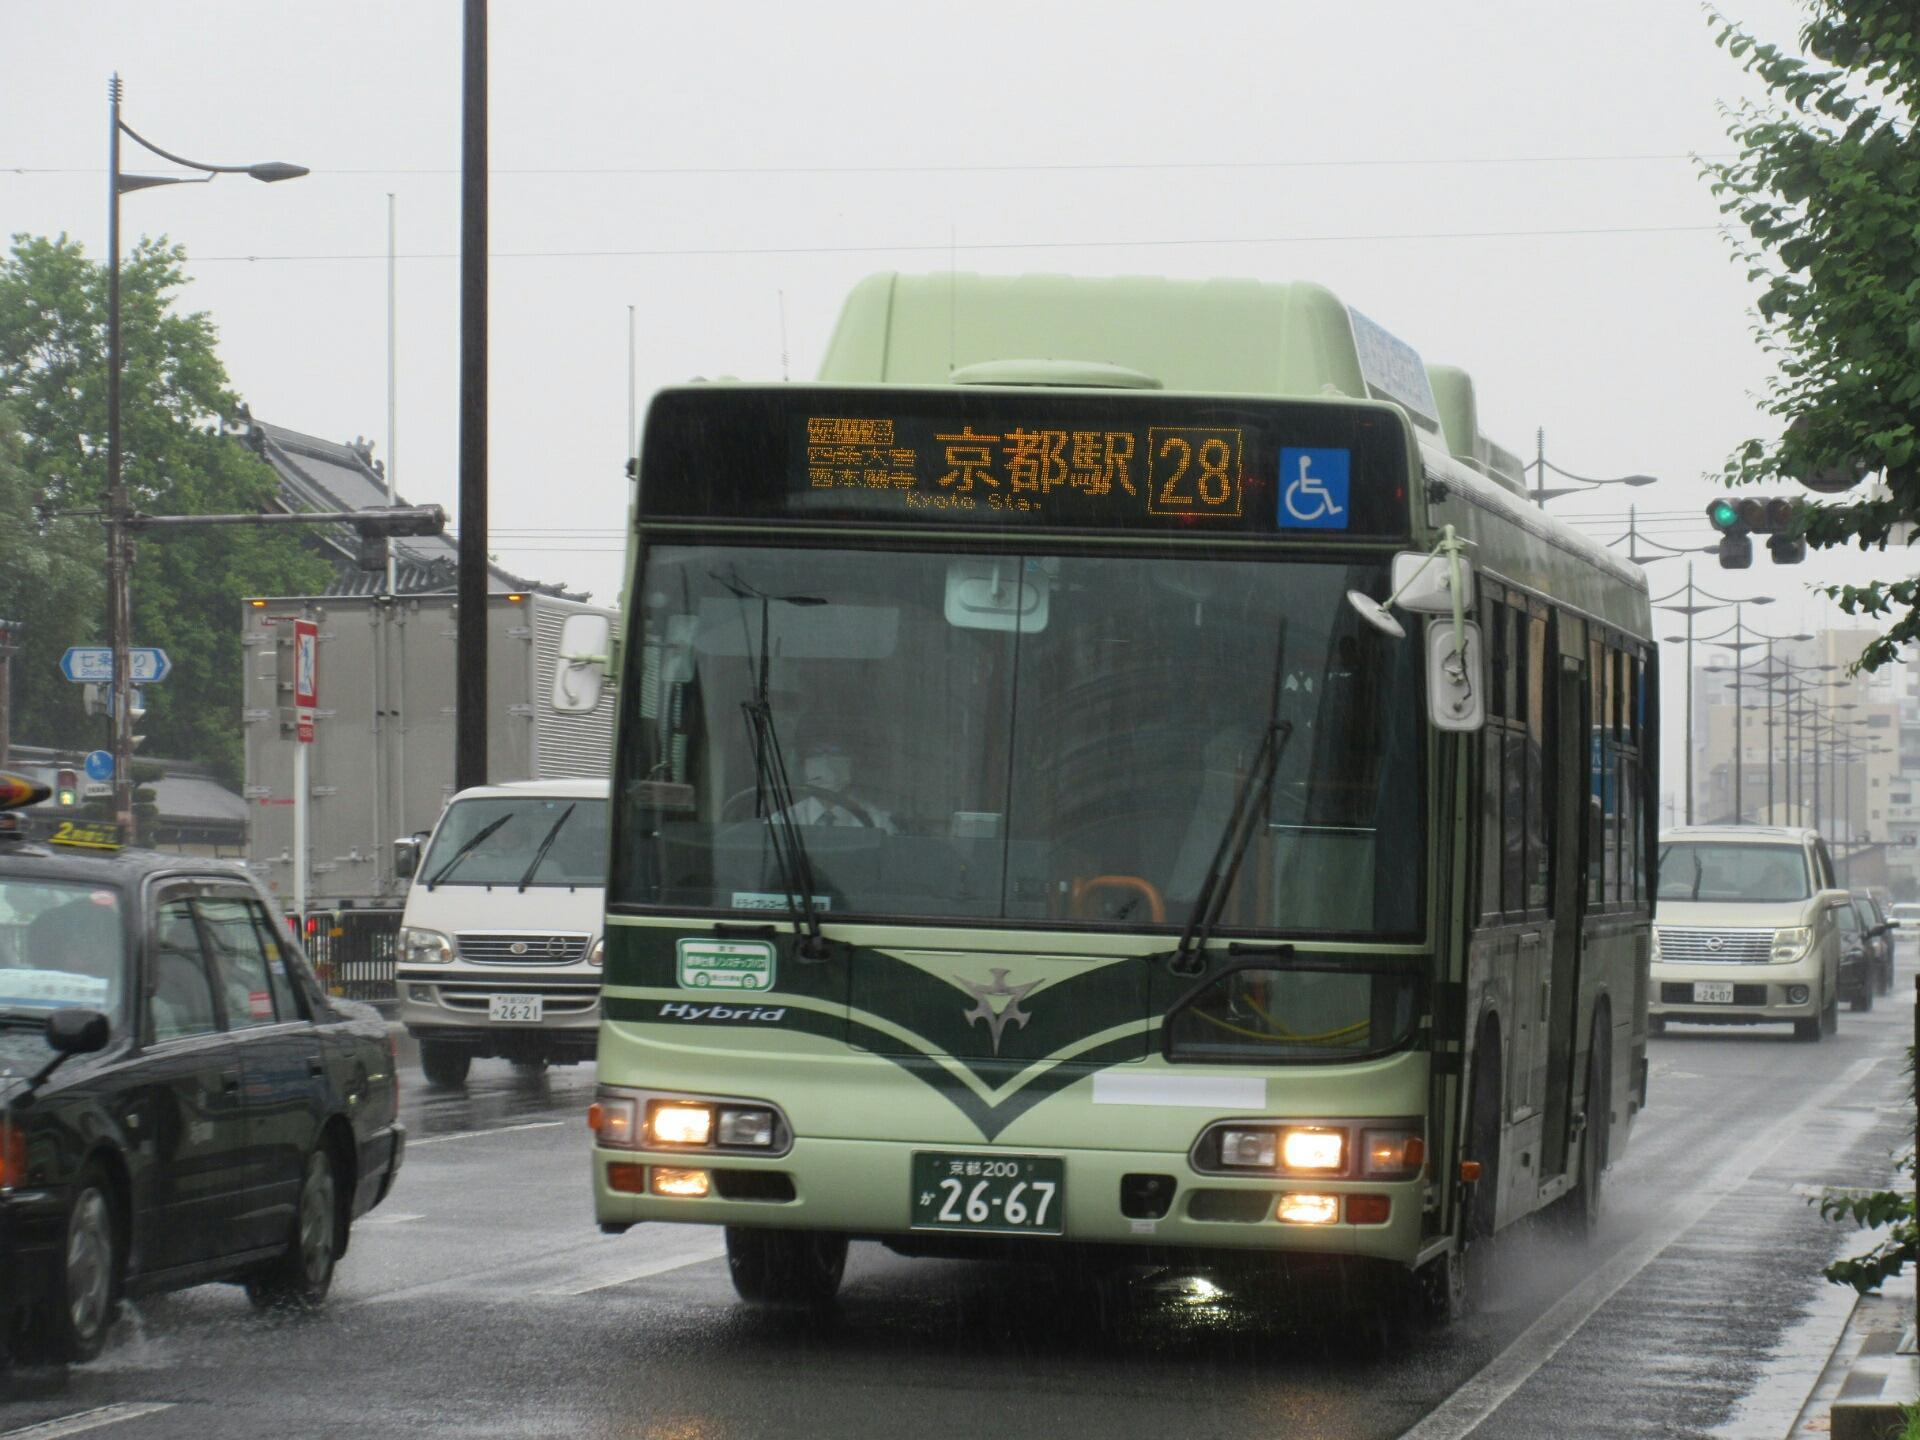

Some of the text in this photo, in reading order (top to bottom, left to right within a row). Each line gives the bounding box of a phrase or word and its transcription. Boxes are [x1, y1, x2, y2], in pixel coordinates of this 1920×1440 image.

[934, 426, 1138, 496] 京都駅
[1158, 436, 1232, 504] 28
[906, 491, 976, 510] Kyoto
[79, 652, 146, 669] 七条り
[501, 1005, 537, 1020] 26-21
[659, 1003, 786, 1022] Hybrid
[949, 1161, 1019, 1178] 京都200
[938, 1178, 1056, 1226] 26-67
